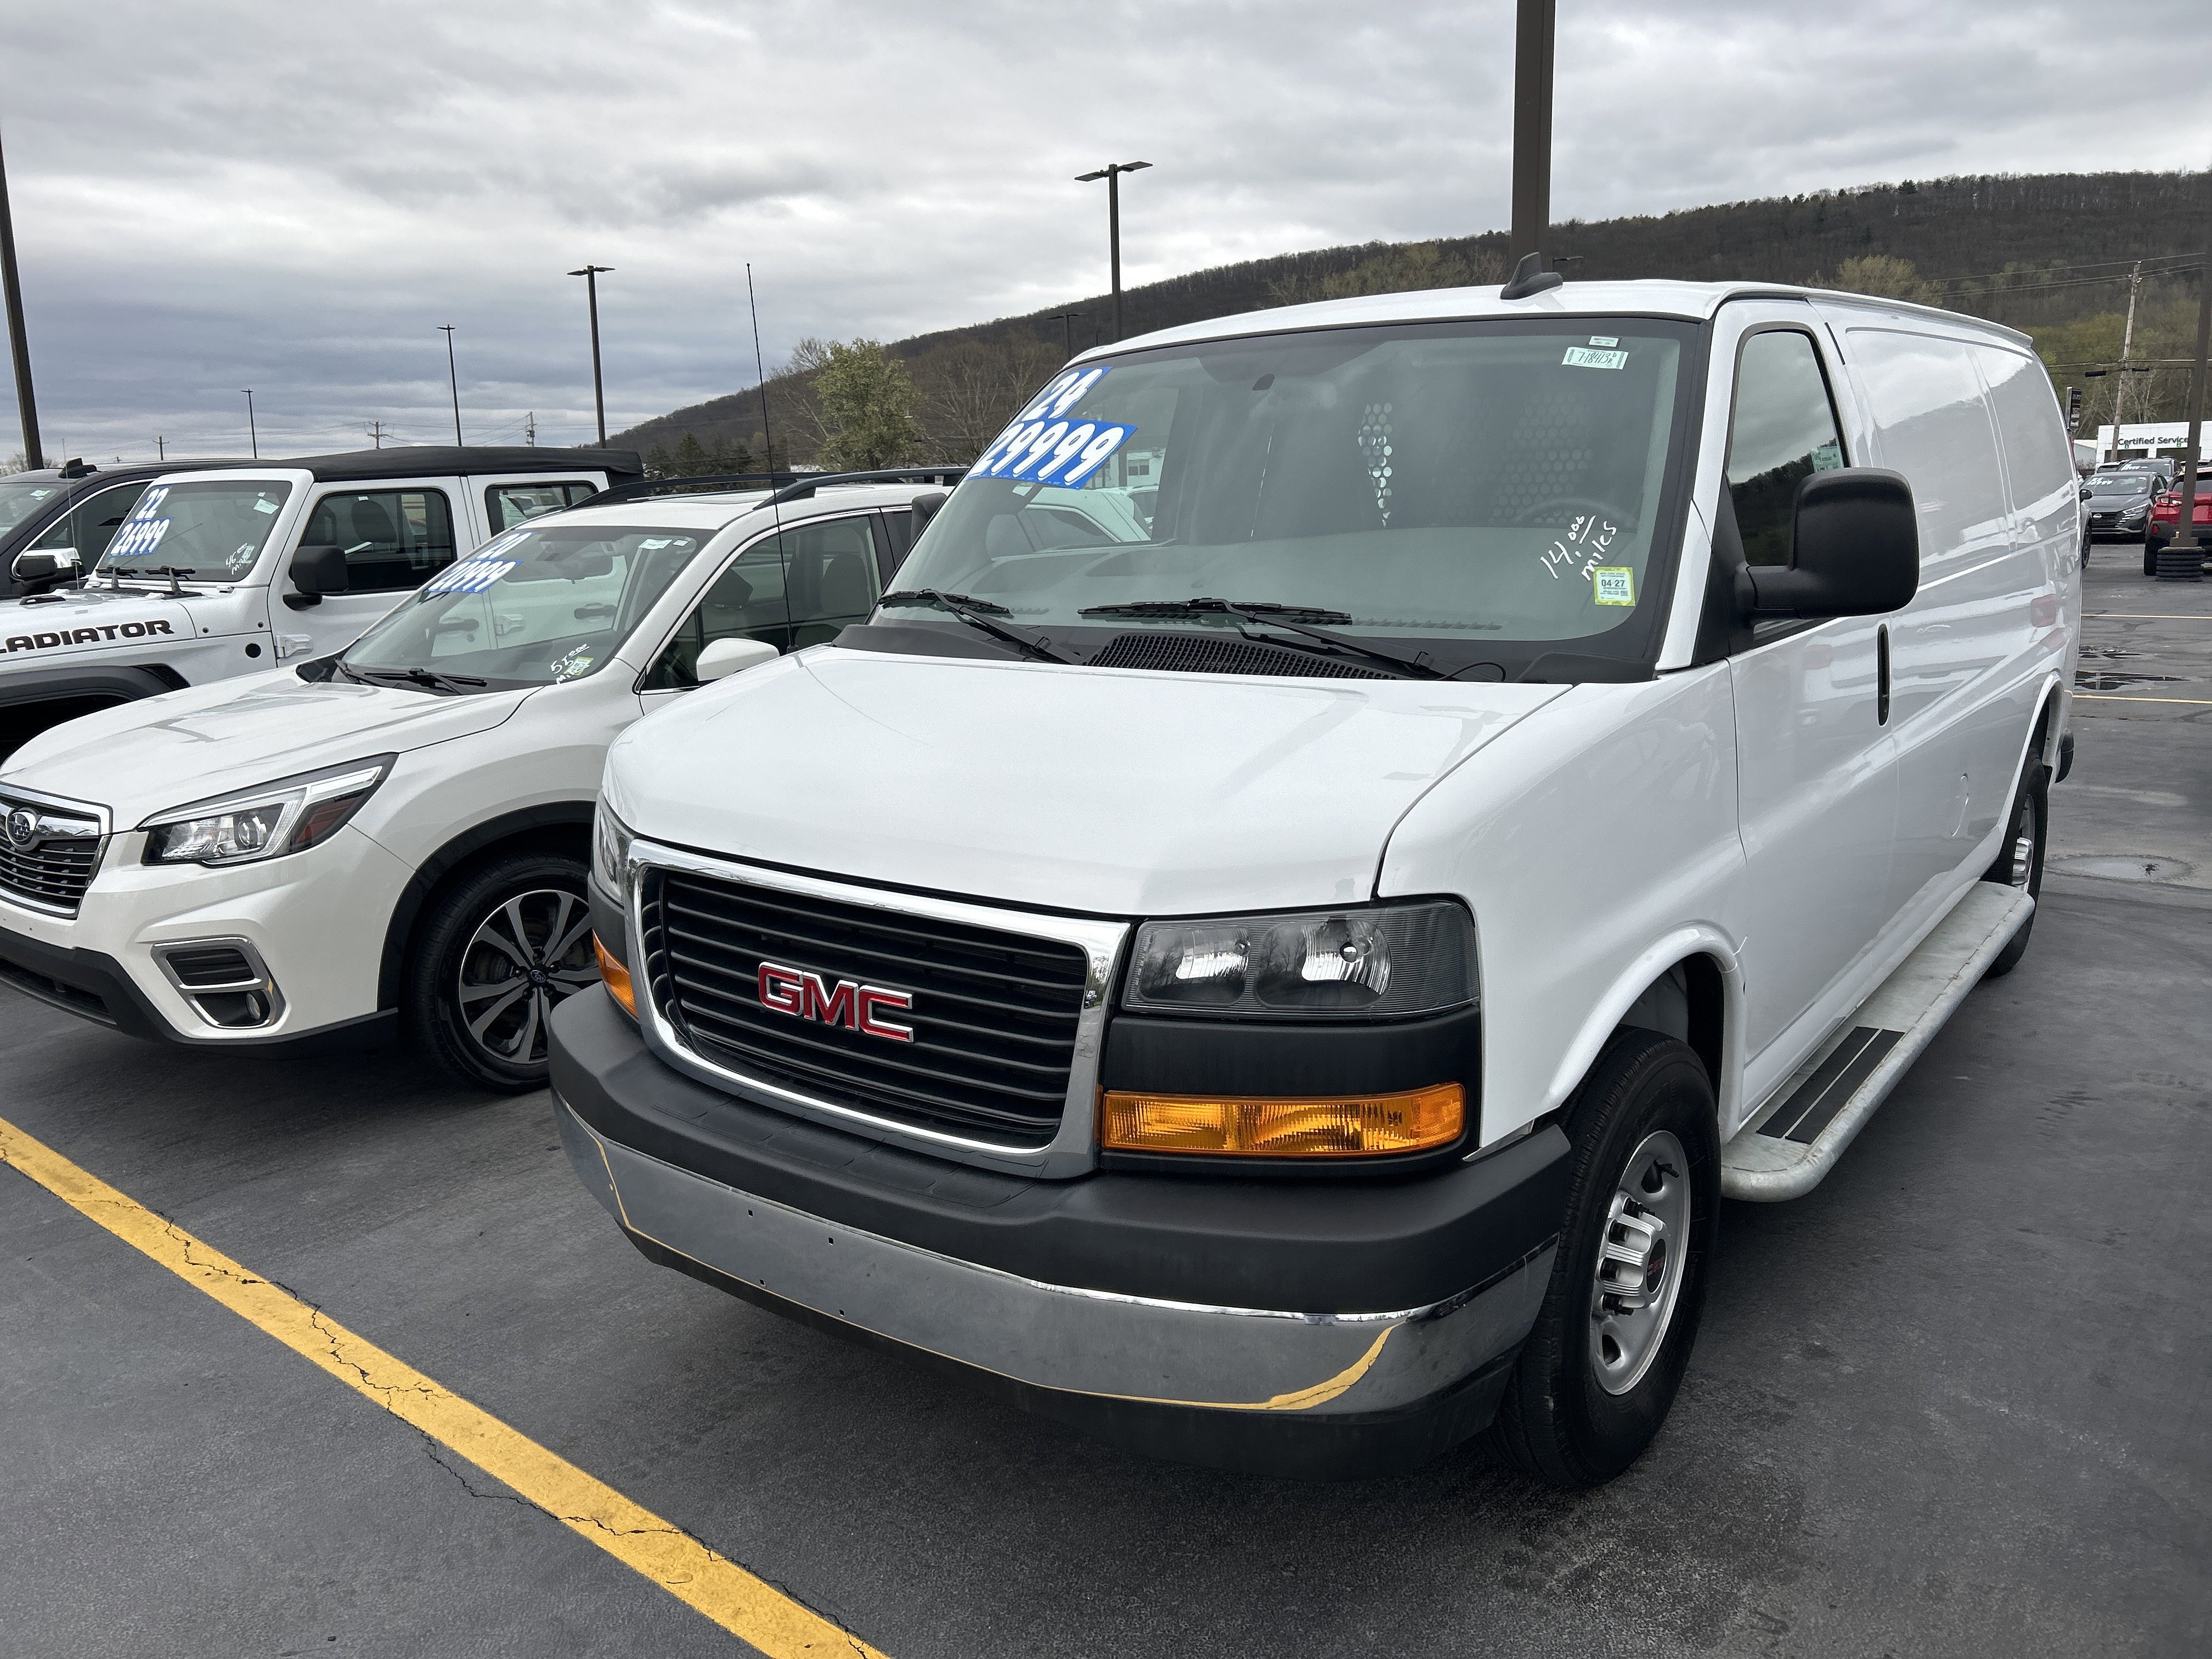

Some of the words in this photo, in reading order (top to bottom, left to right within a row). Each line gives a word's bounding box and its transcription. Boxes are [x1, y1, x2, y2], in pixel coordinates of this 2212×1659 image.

[1022, 368, 1103, 422] 24
[968, 421, 1125, 486] 29999
[2118, 437, 2155, 445] Certified
[135, 487, 169, 521] 22
[110, 518, 170, 556] 26999
[476, 532, 532, 560] 20
[428, 560, 516, 592] 20999
[0, 619, 175, 653] ADIATOR
[758, 961, 914, 1043] GMC
